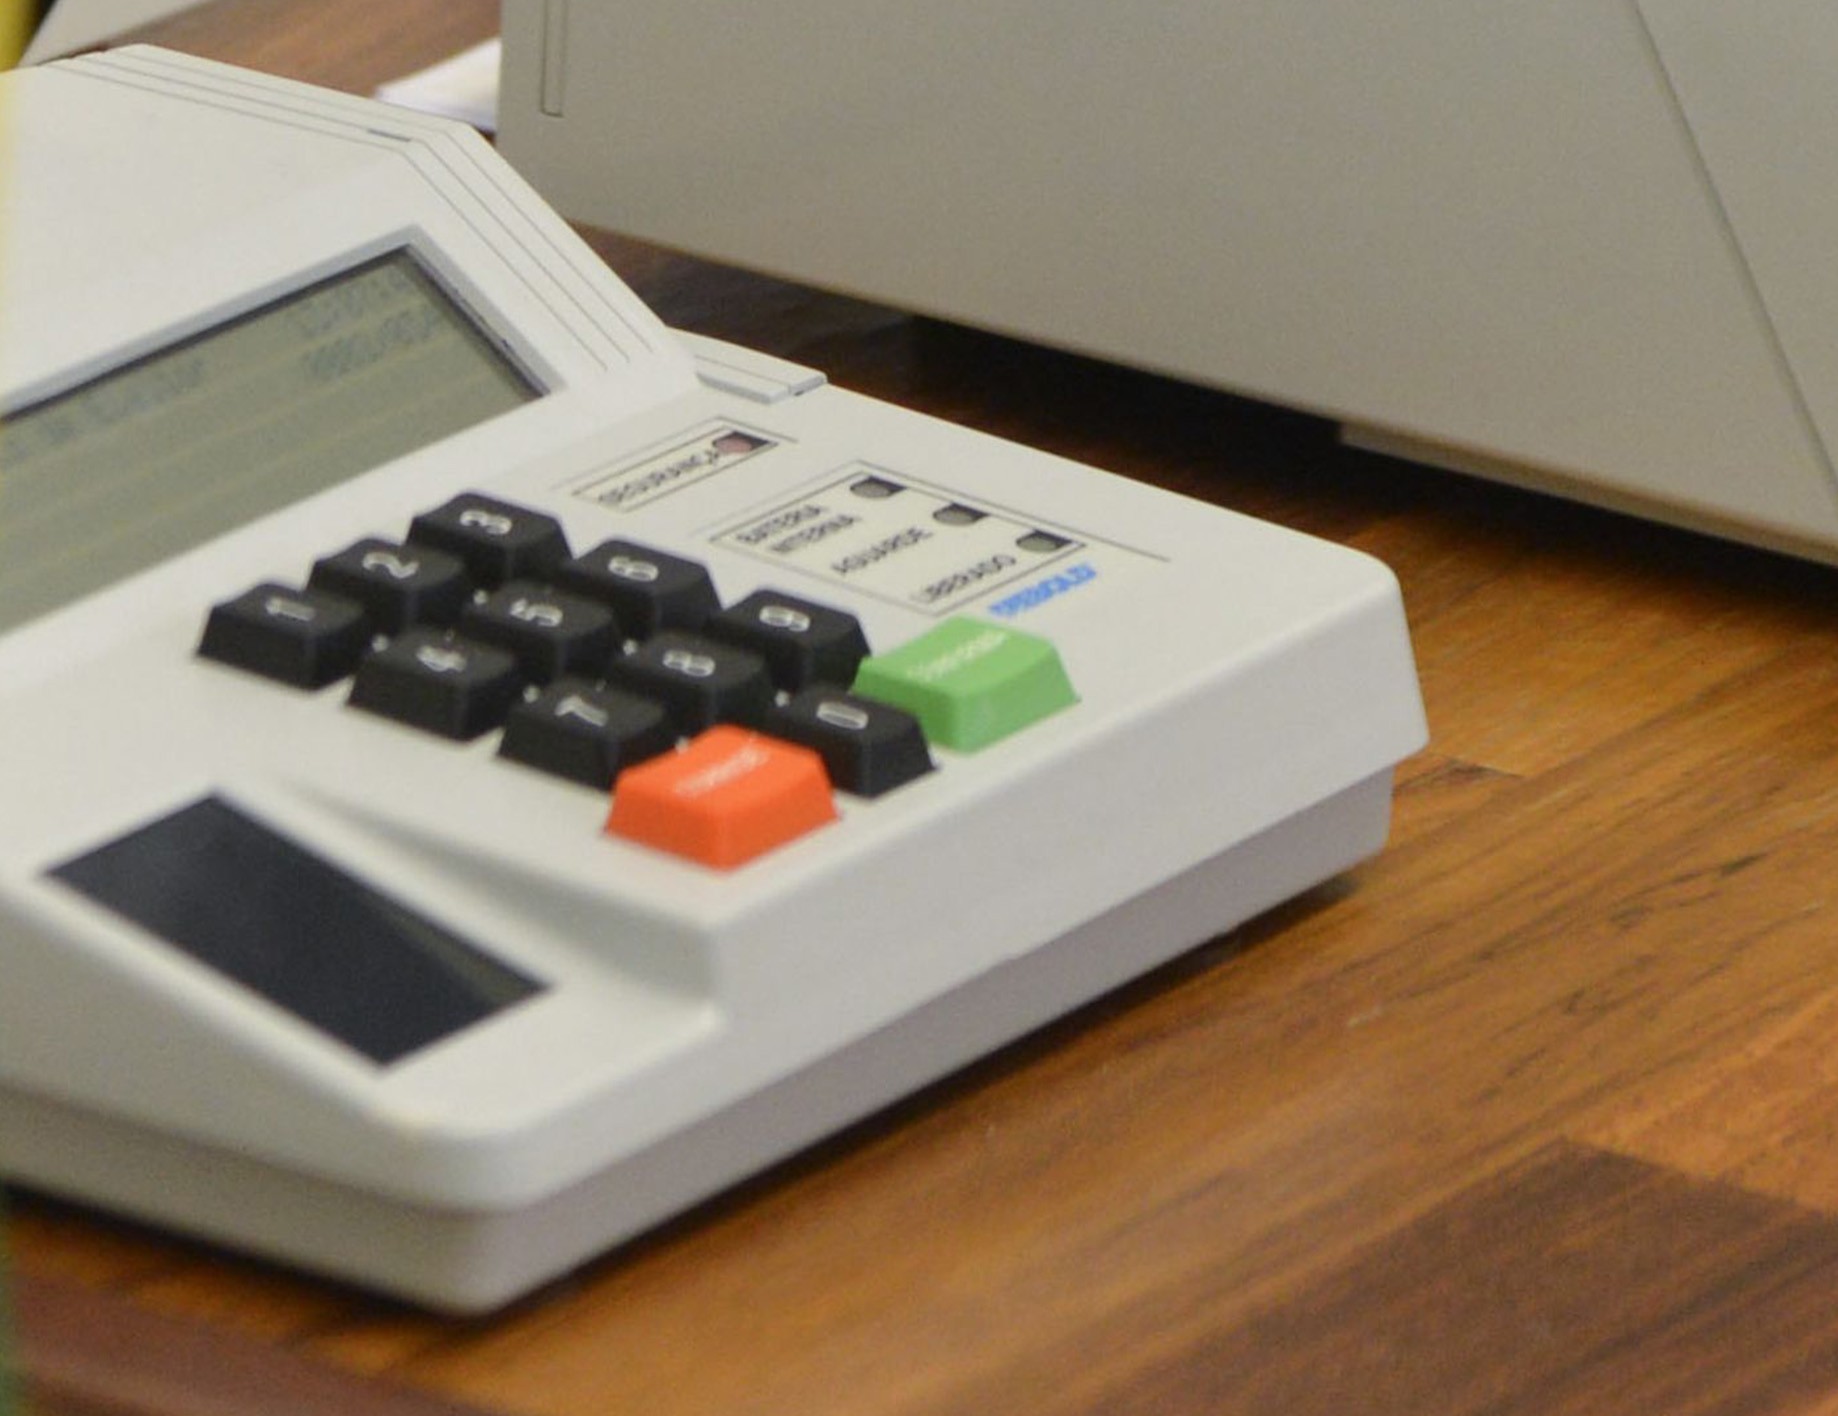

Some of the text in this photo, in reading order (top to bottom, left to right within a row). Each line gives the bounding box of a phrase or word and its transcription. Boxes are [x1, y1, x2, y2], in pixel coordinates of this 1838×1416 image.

[266, 508, 512, 621] 1 2 3
[416, 554, 658, 673] 4 5 6
[556, 603, 810, 726] 7 8 9
[816, 701, 868, 729] 0
